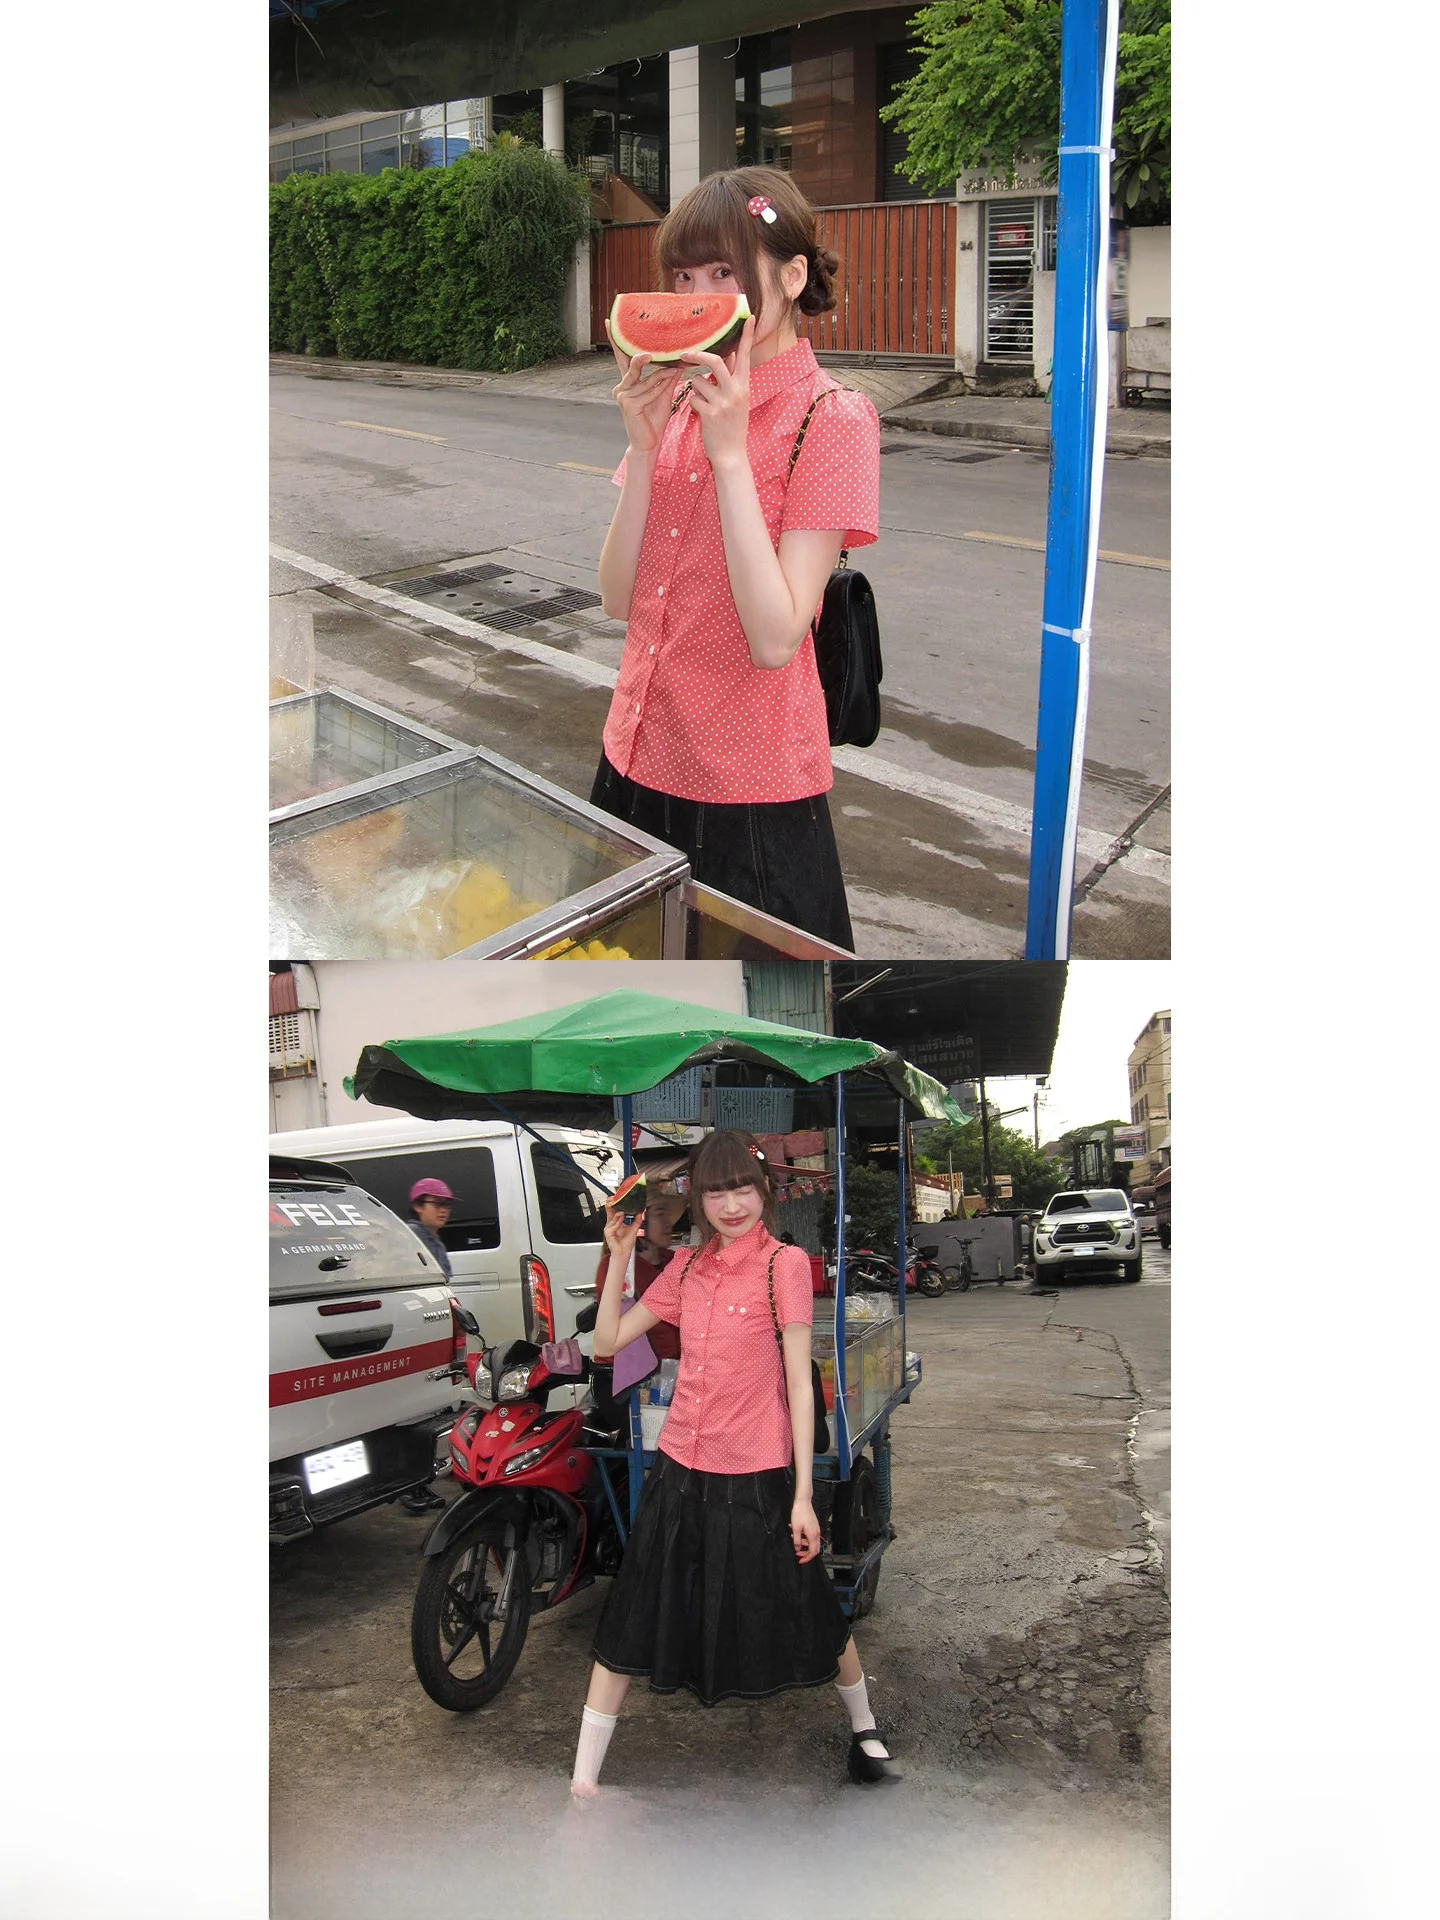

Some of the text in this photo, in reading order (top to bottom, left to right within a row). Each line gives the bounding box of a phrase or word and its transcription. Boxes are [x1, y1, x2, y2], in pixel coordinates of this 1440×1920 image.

[281, 1243, 366, 1256] A GERMAN BRAND
[294, 1356, 411, 1392] SITE MANAGEMENT
